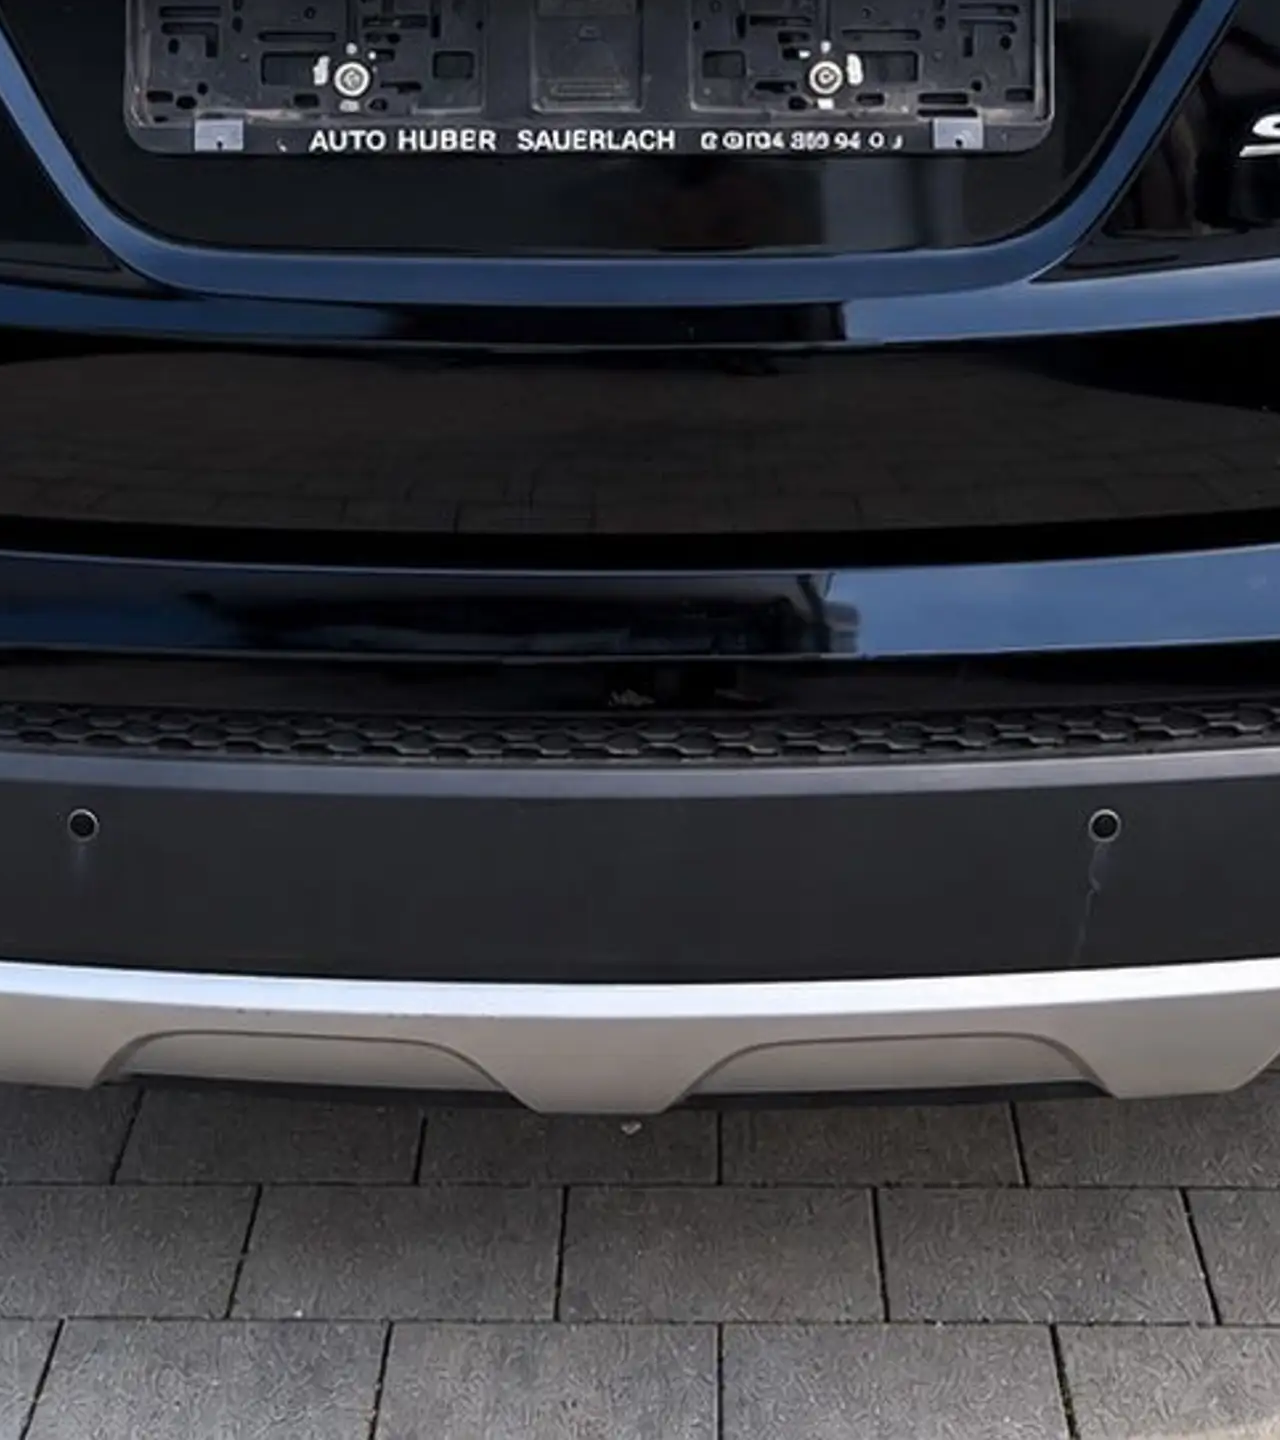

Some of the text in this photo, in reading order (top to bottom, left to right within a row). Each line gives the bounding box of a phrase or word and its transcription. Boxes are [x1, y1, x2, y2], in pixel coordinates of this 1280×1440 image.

[308, 129, 387, 152] AUTO
[397, 129, 497, 152] HUBER
[517, 129, 676, 152] SAUERLACH
